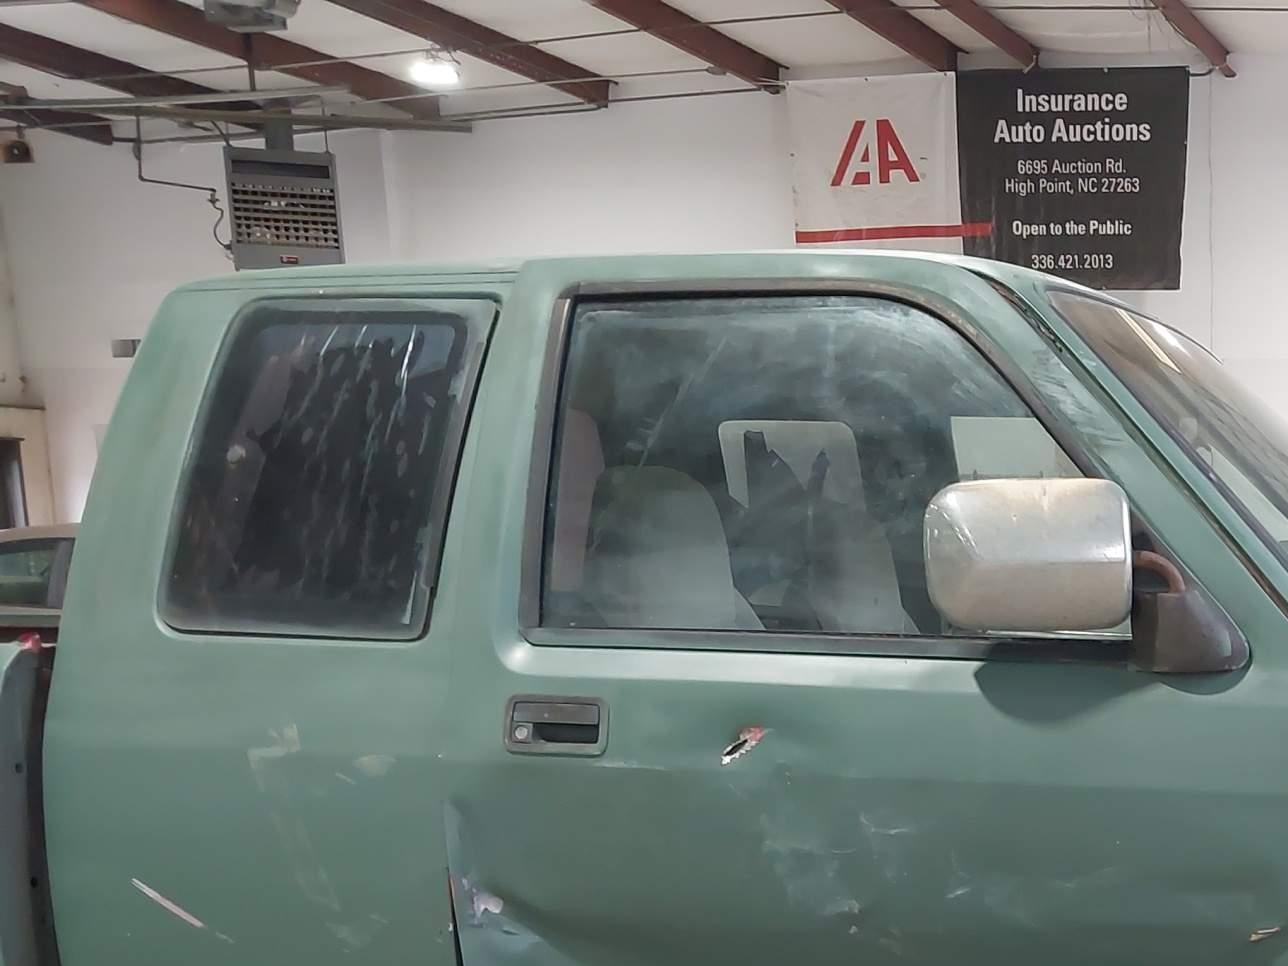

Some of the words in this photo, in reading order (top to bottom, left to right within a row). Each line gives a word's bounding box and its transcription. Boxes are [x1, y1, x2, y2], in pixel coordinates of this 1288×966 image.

[1016, 88, 1129, 113] Insurance
[993, 119, 1045, 144] Auto
[1051, 117, 1151, 143] Auctions
[1017, 159, 1048, 175] 6695
[1051, 158, 1102, 175] Auction
[1105, 158, 1127, 174] Rd.
[1005, 178, 1035, 196] High
[1039, 178, 1074, 195] Point,
[1078, 178, 1098, 193] NC
[1101, 177, 1140, 193] 27263
[1012, 220, 1047, 238] Open
[1049, 222, 1063, 236] to
[1064, 220, 1086, 236] the
[1089, 219, 1132, 235] Public
[1031, 254, 1113, 270] 336.421.2013
